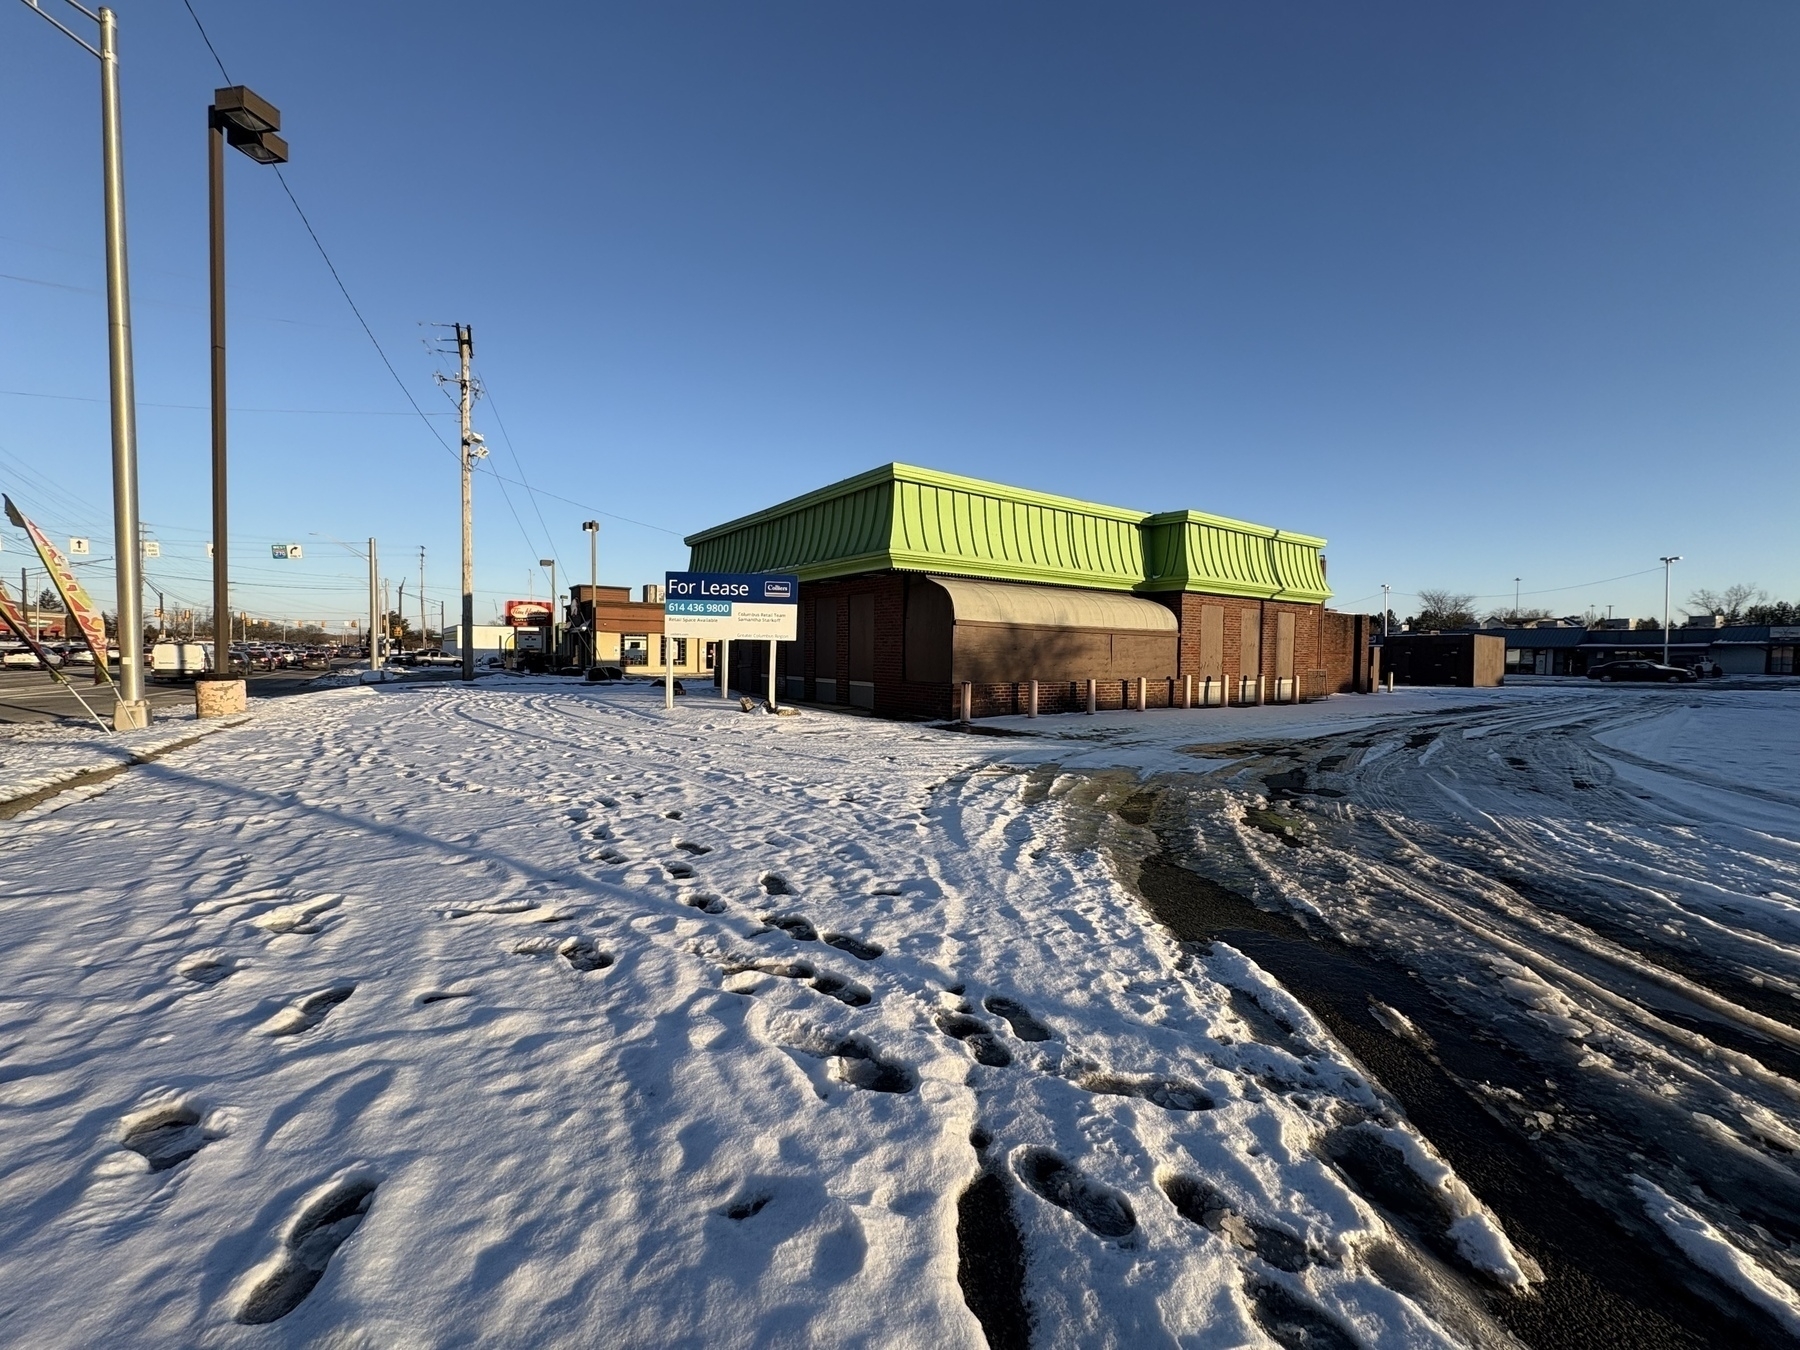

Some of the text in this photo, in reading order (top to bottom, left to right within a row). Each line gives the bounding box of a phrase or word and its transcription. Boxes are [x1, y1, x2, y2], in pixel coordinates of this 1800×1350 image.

[668, 579, 749, 596] For Lease
[668, 602, 730, 613] 614 436 9800
